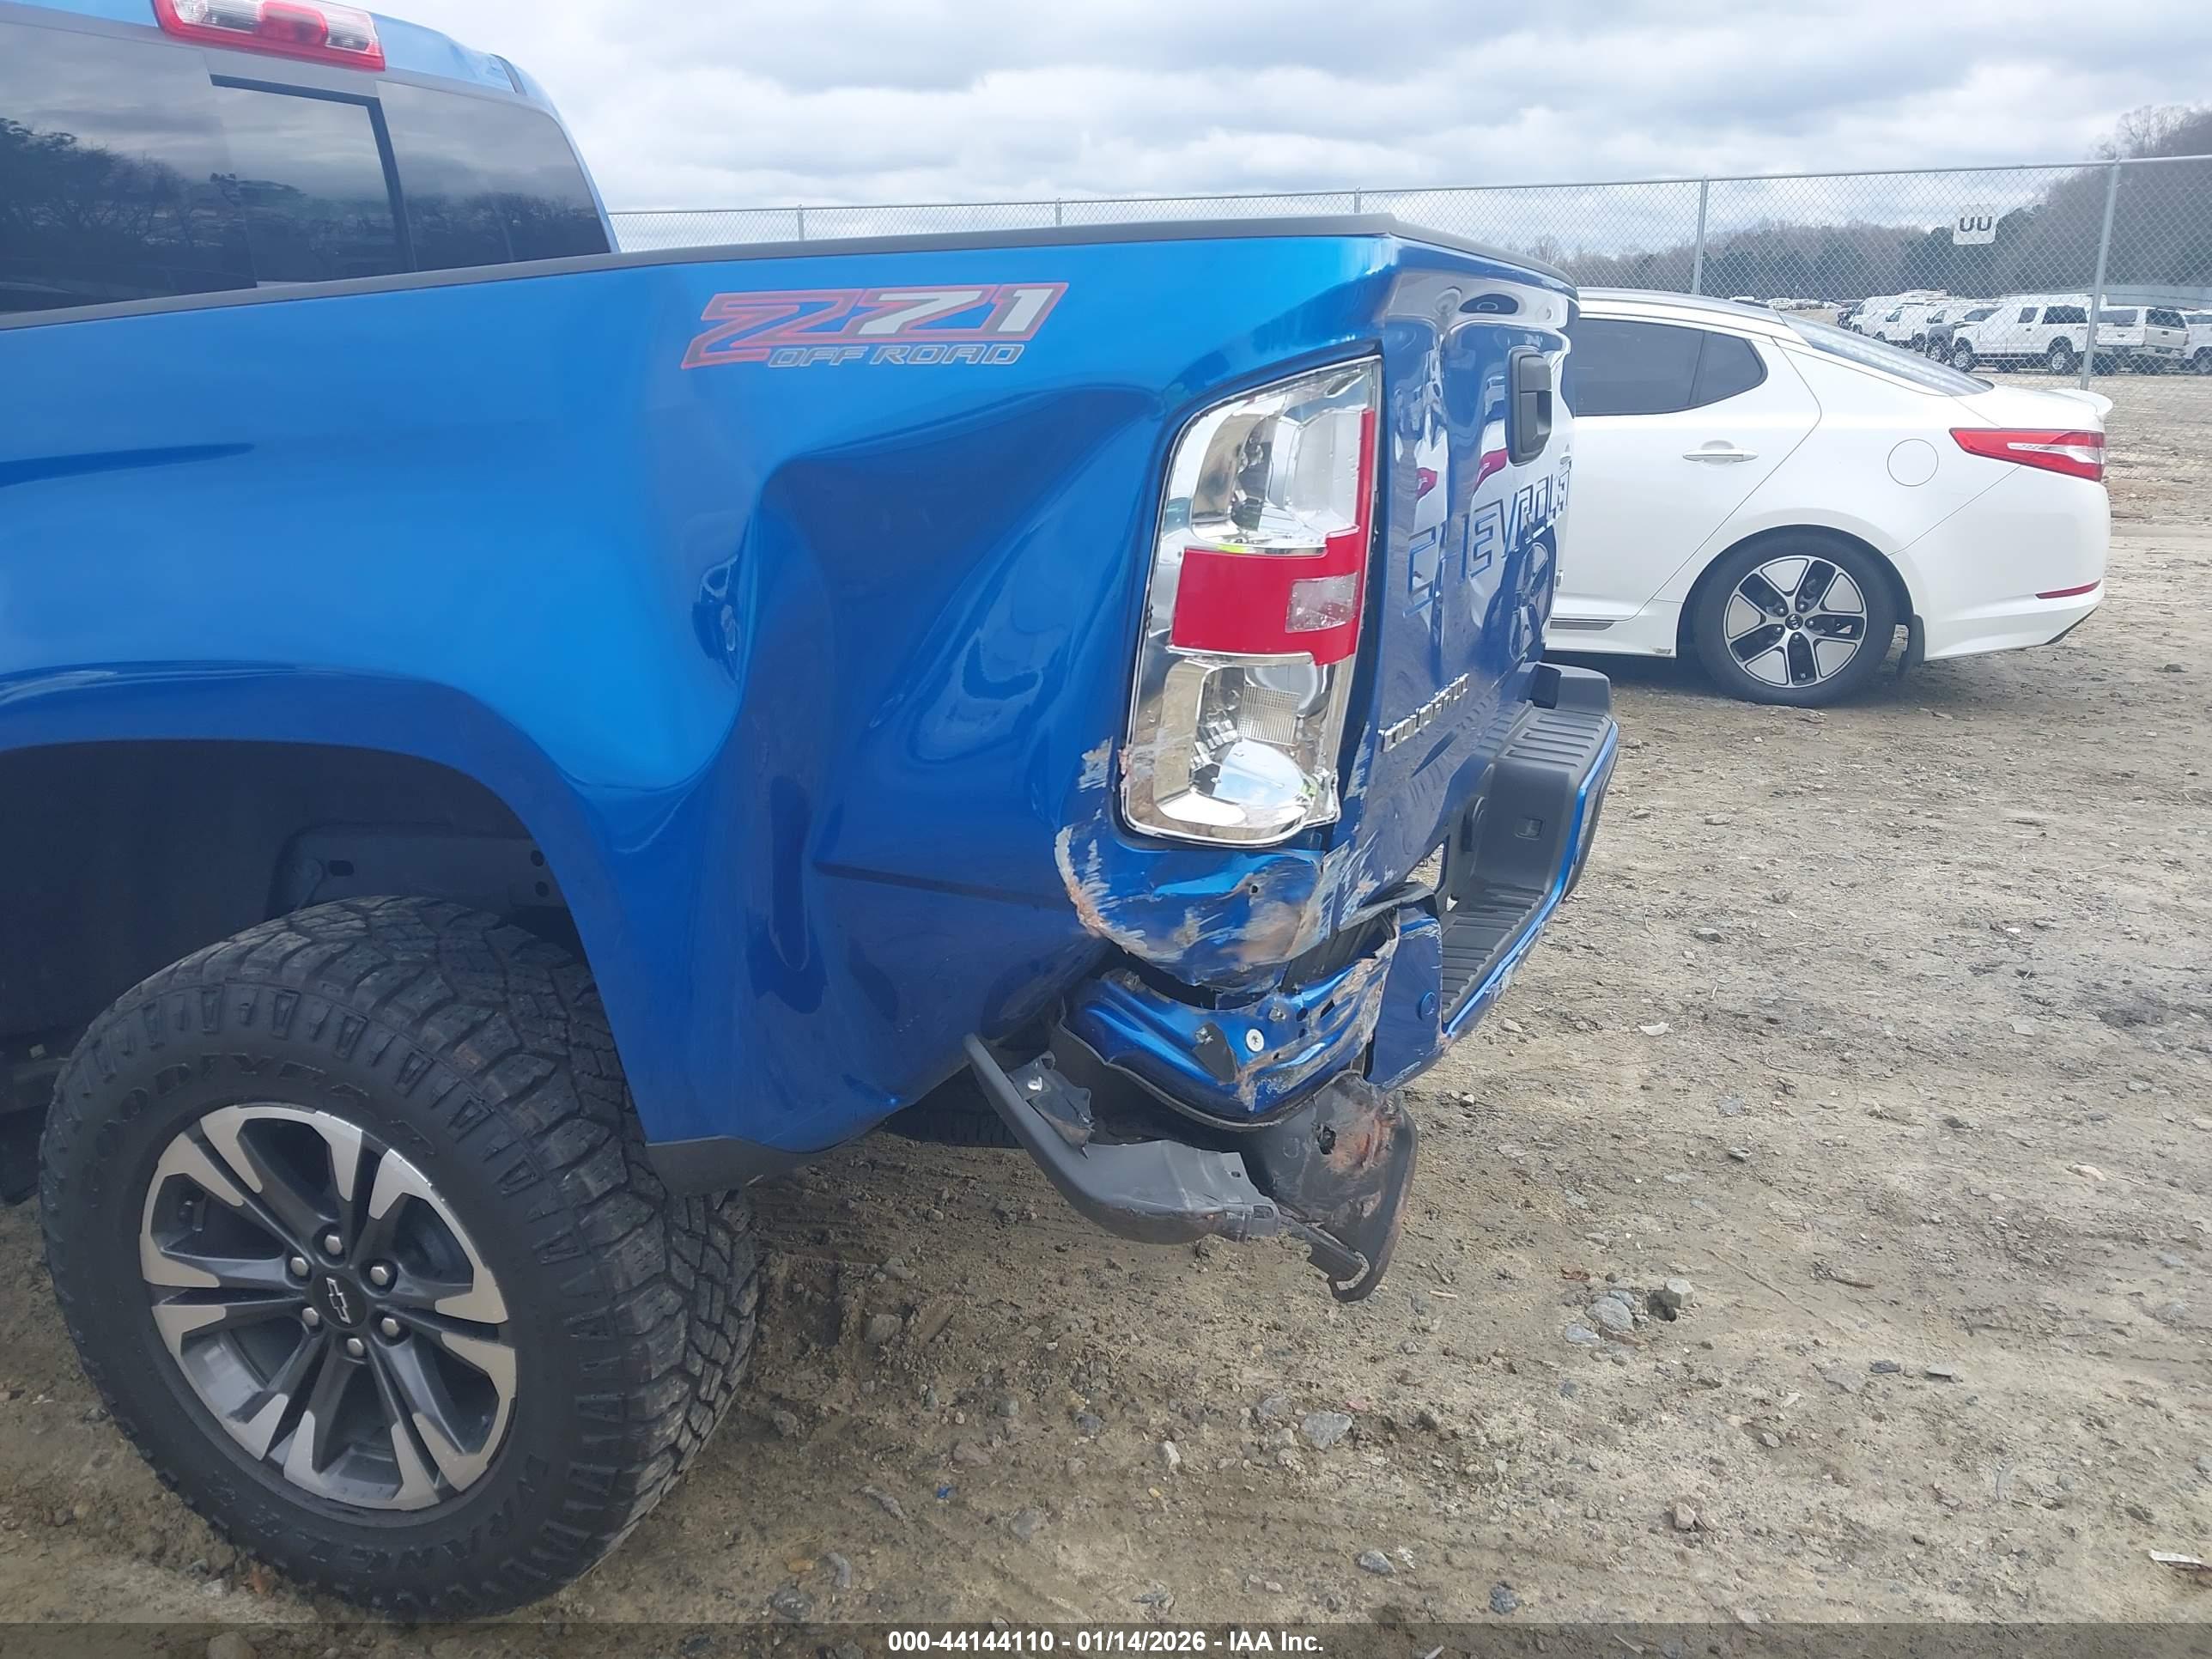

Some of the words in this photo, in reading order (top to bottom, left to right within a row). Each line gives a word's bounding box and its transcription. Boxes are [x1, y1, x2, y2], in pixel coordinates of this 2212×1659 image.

[680, 282, 1070, 370] Z71
[768, 345, 866, 368] OFF
[869, 343, 1030, 366] ROAD
